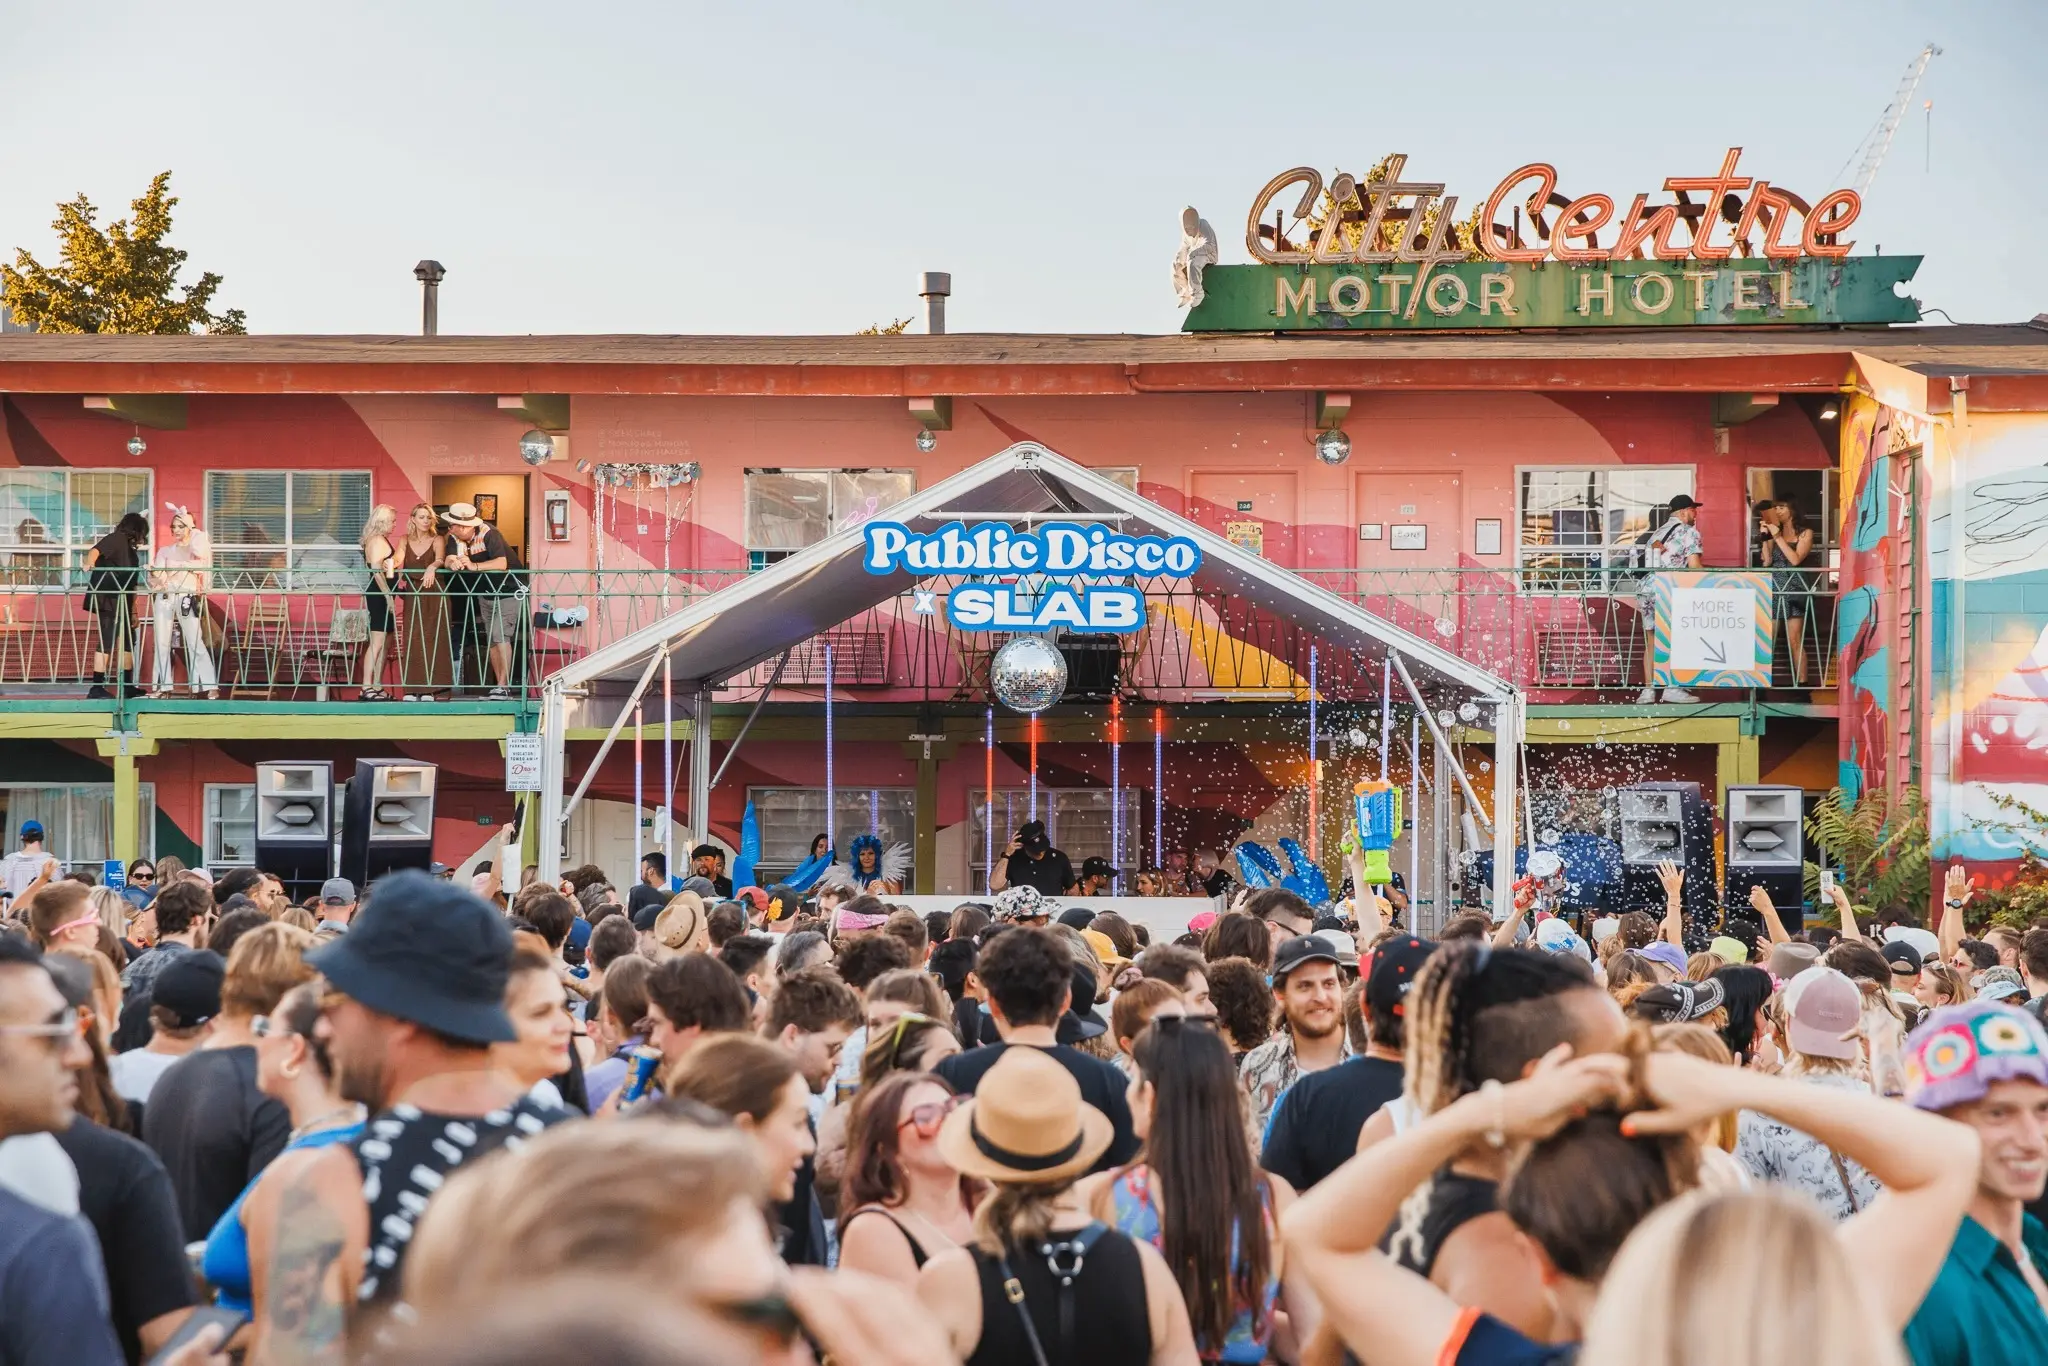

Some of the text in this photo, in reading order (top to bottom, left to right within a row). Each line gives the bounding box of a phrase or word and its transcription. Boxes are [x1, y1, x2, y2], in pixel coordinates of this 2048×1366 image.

[1246, 147, 1861, 318] City Centre
[1276, 270, 1813, 318] MOTOR HOTEL
[870, 527, 1196, 572] Public Disco
[953, 589, 1140, 627] SLAB
[1681, 616, 1746, 629] STUDIOS
[1692, 600, 1734, 613] MORE
